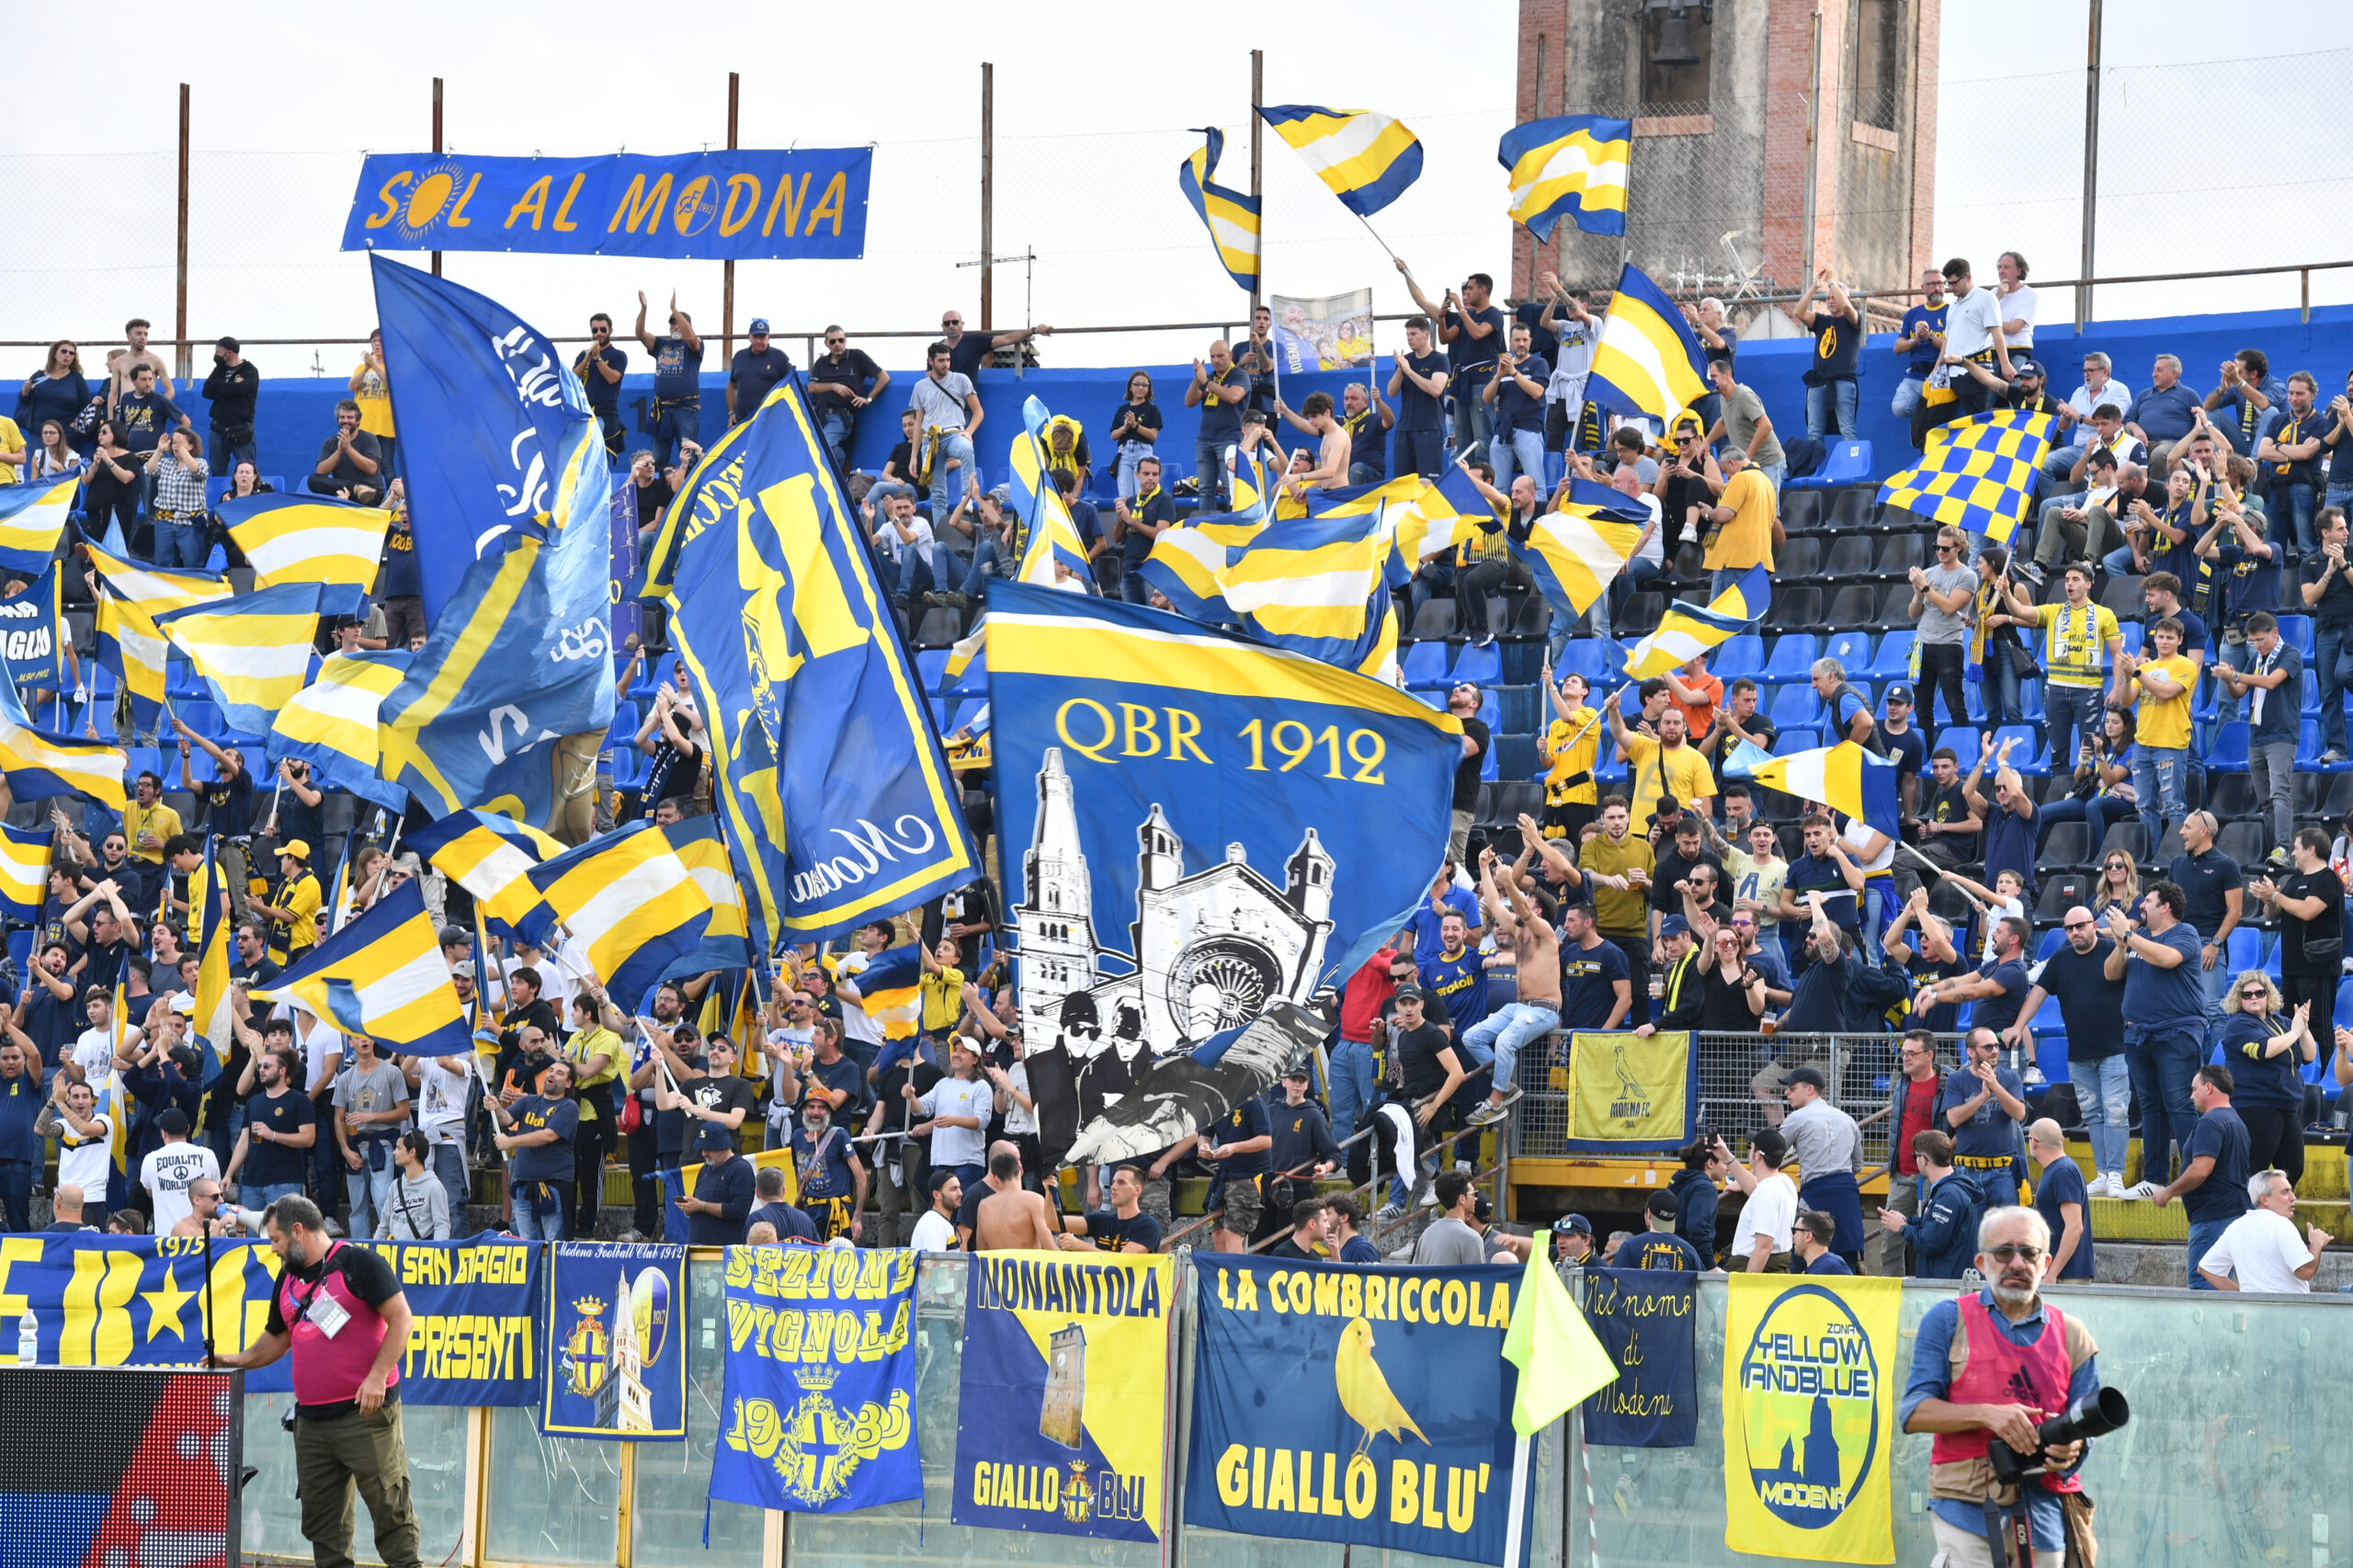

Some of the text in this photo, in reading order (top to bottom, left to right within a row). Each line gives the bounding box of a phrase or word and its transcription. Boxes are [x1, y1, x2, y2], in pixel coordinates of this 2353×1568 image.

[365, 166, 483, 235] SOL
[504, 173, 588, 232] AL
[2086, 603, 2096, 640] FORZA
[1055, 698, 1386, 786] QBR 1912
[1609, 1102, 1651, 1119] MODENA FC
[156, 1153, 204, 1173] EQUALITY
[158, 1173, 205, 1192] WORLDW
[154, 1235, 206, 1257] 1975
[403, 1245, 450, 1285] SAN
[556, 1241, 683, 1259] Modena Football Club 1912
[977, 1256, 1161, 1319] NONANTOLA
[1217, 1267, 1511, 1329] LA COMBRICCOLA
[1584, 1274, 1692, 1317] Nel nome
[405, 1315, 533, 1381] PRESENTI
[726, 1296, 912, 1364] VIGNOLA
[1623, 1327, 1644, 1367] di
[1826, 1323, 1858, 1336] ZONA
[1756, 1333, 1867, 1367] YELLOW
[1745, 1361, 1872, 1400] ANDBLUE
[724, 1393, 781, 1460] 19
[972, 1460, 1146, 1521] GIALLO BLU
[1216, 1443, 1490, 1533] GIALLO BLU'
[1759, 1480, 1847, 1511] MODENA
[2017, 1524, 2028, 1545] EOS
